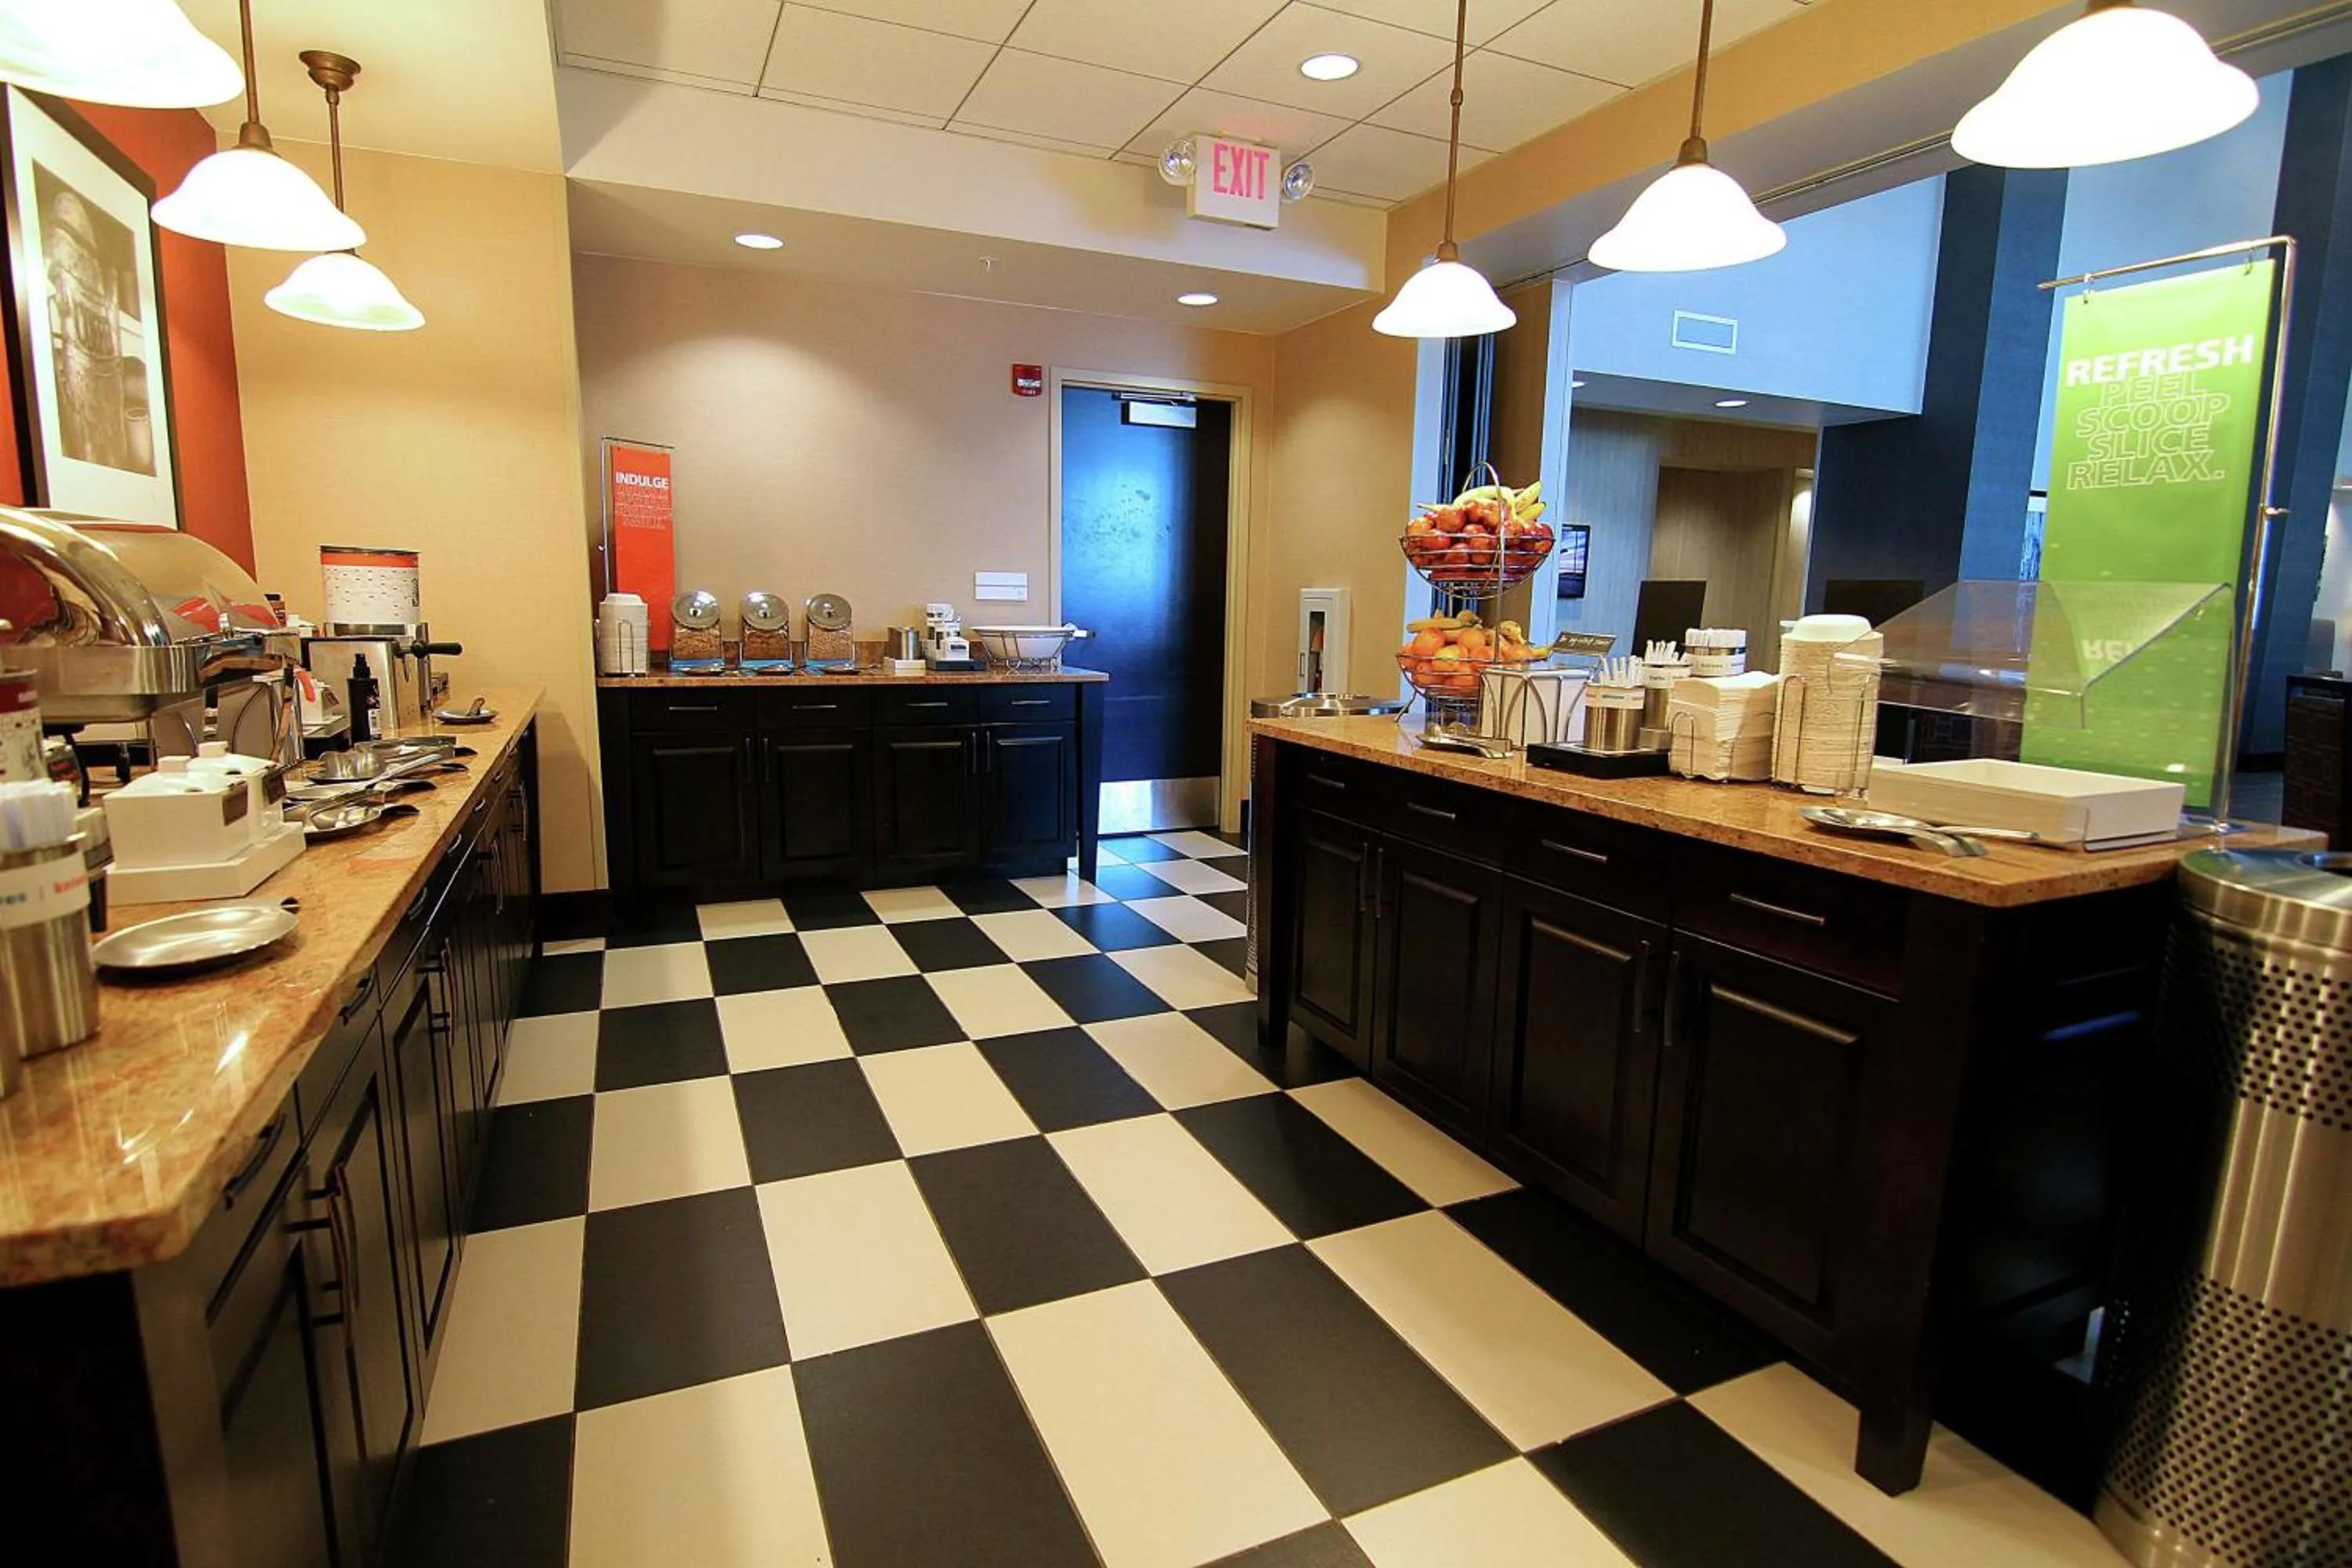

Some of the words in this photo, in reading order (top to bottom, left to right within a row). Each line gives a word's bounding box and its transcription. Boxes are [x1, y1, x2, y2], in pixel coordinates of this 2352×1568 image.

[1212, 143, 1270, 201] EXIT
[2065, 332, 2256, 387] REFRESH
[2100, 371, 2208, 407] PEEL
[2076, 392, 2230, 437] SCOOP
[2086, 423, 2210, 463] SLICE
[615, 471, 669, 490] INDULGE
[2067, 449, 2225, 490] RELAX.
